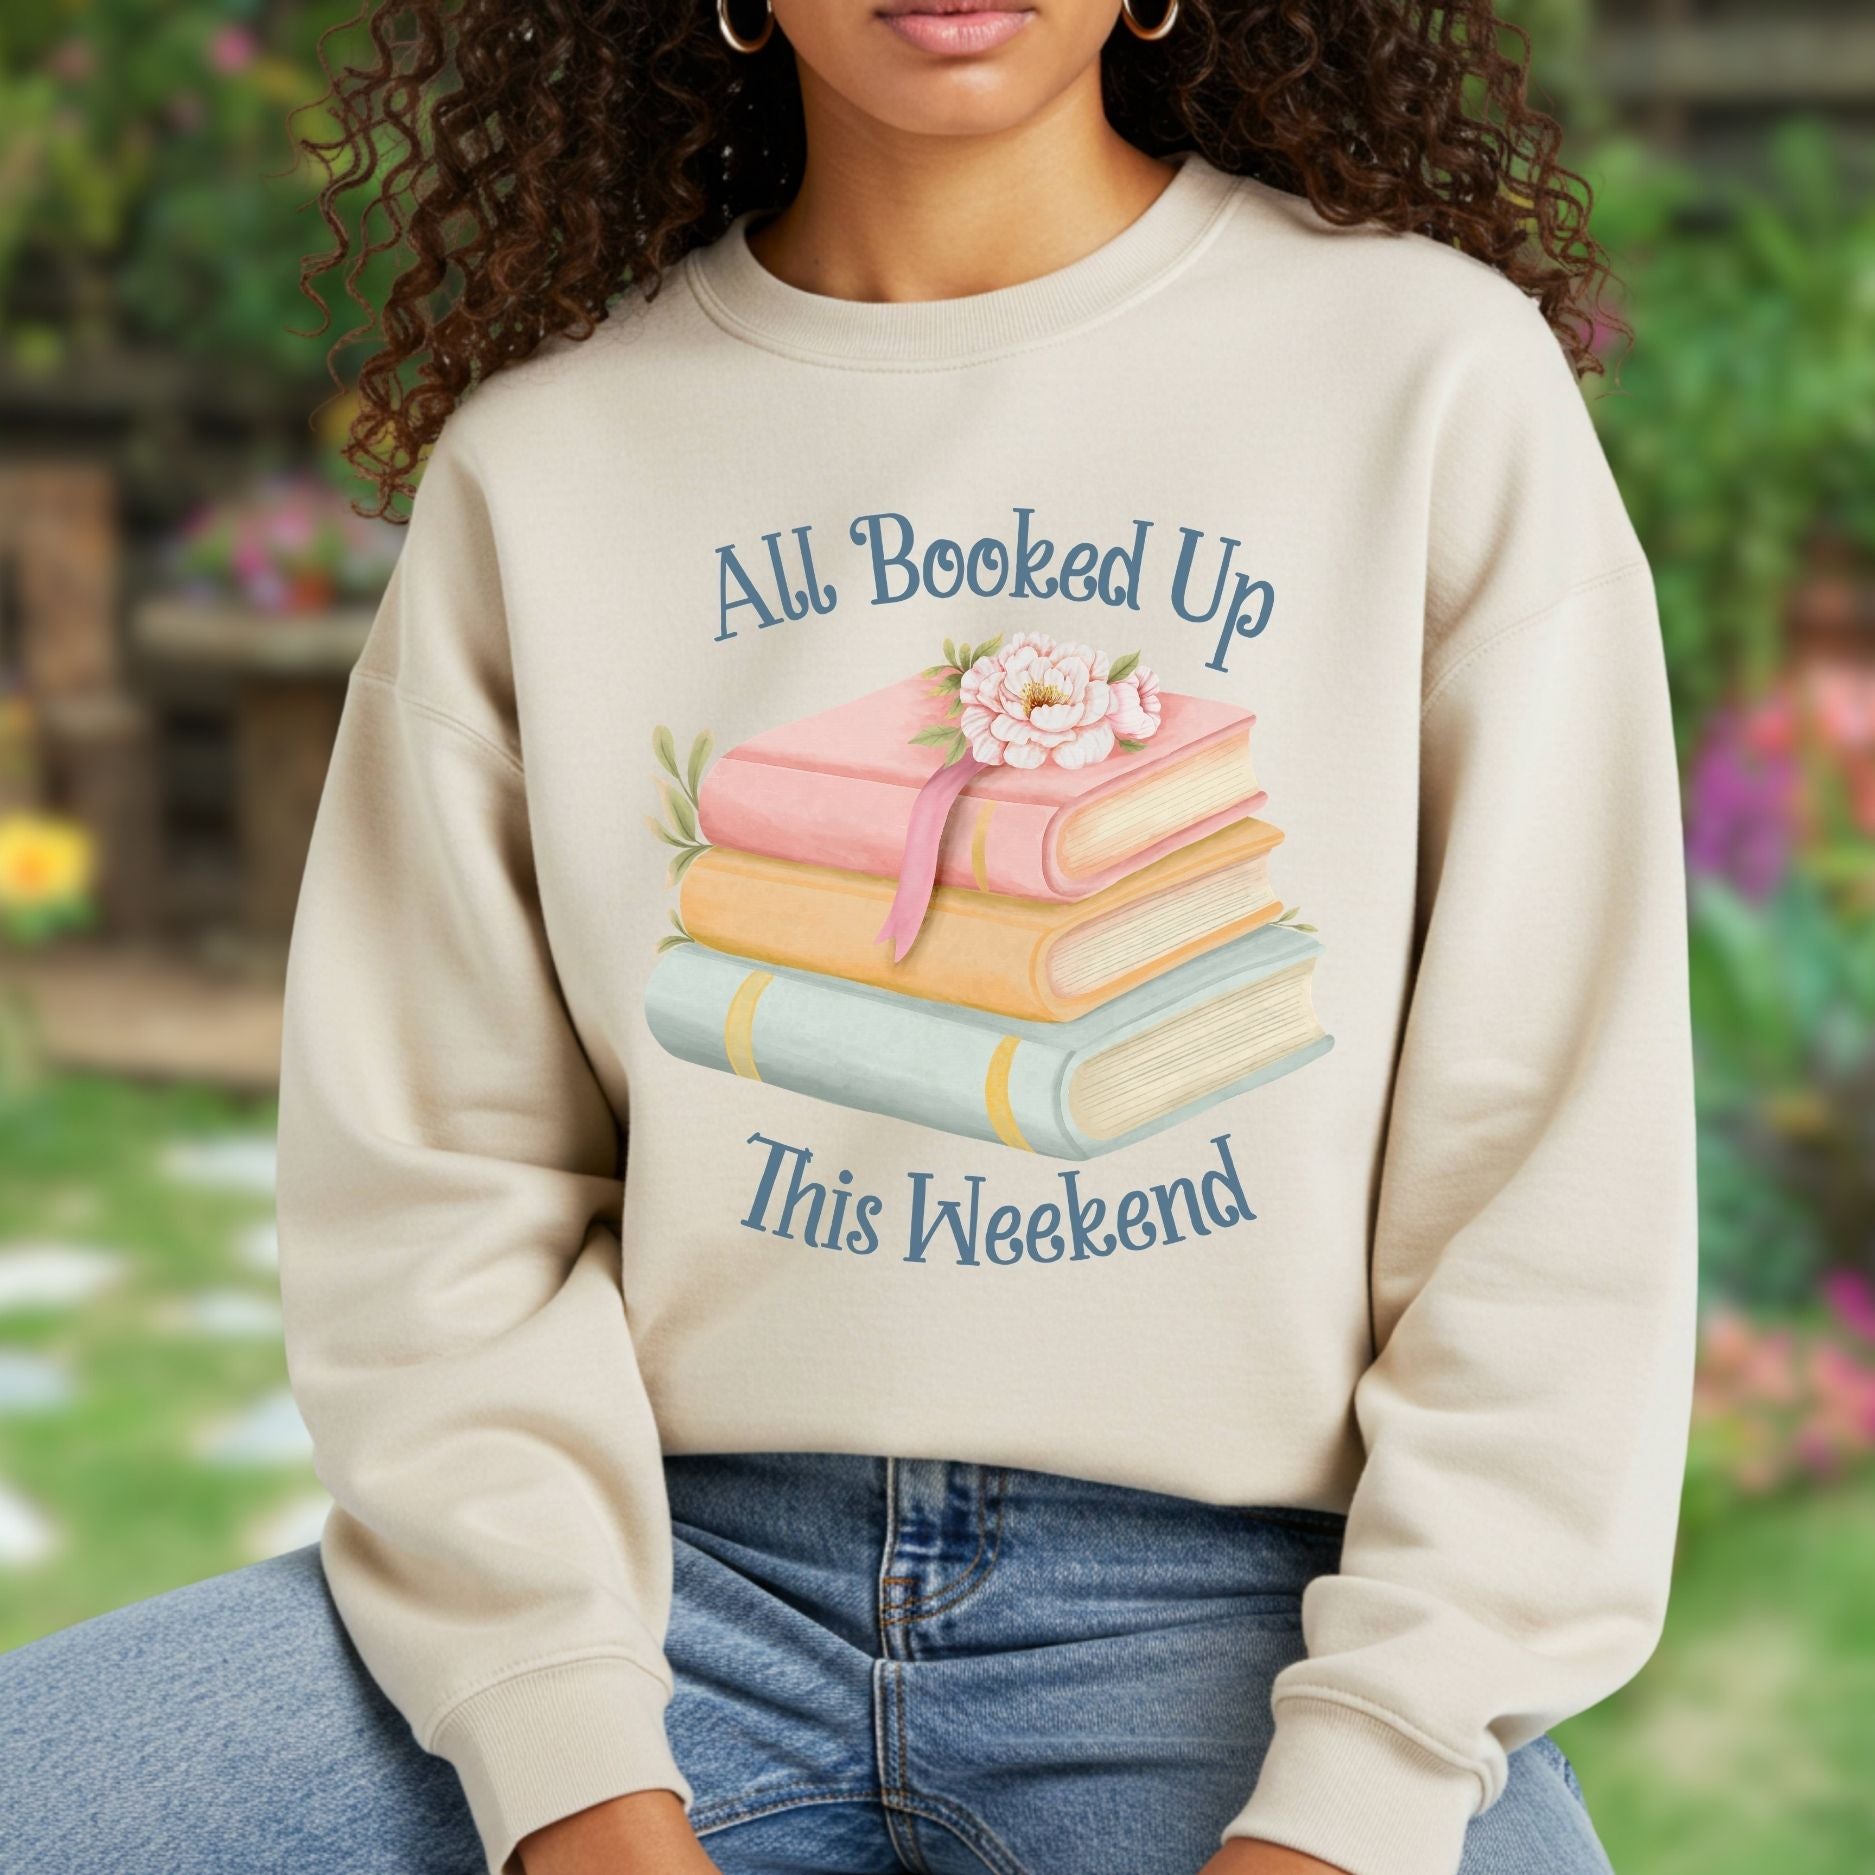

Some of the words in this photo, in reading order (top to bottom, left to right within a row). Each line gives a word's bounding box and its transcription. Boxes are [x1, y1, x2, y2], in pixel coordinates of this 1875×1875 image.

[714, 525, 837, 642] All
[849, 508, 1153, 611] Booked
[1171, 527, 1274, 673] Up
[740, 1132, 882, 1255] This
[903, 1134, 1257, 1266] Weekend
